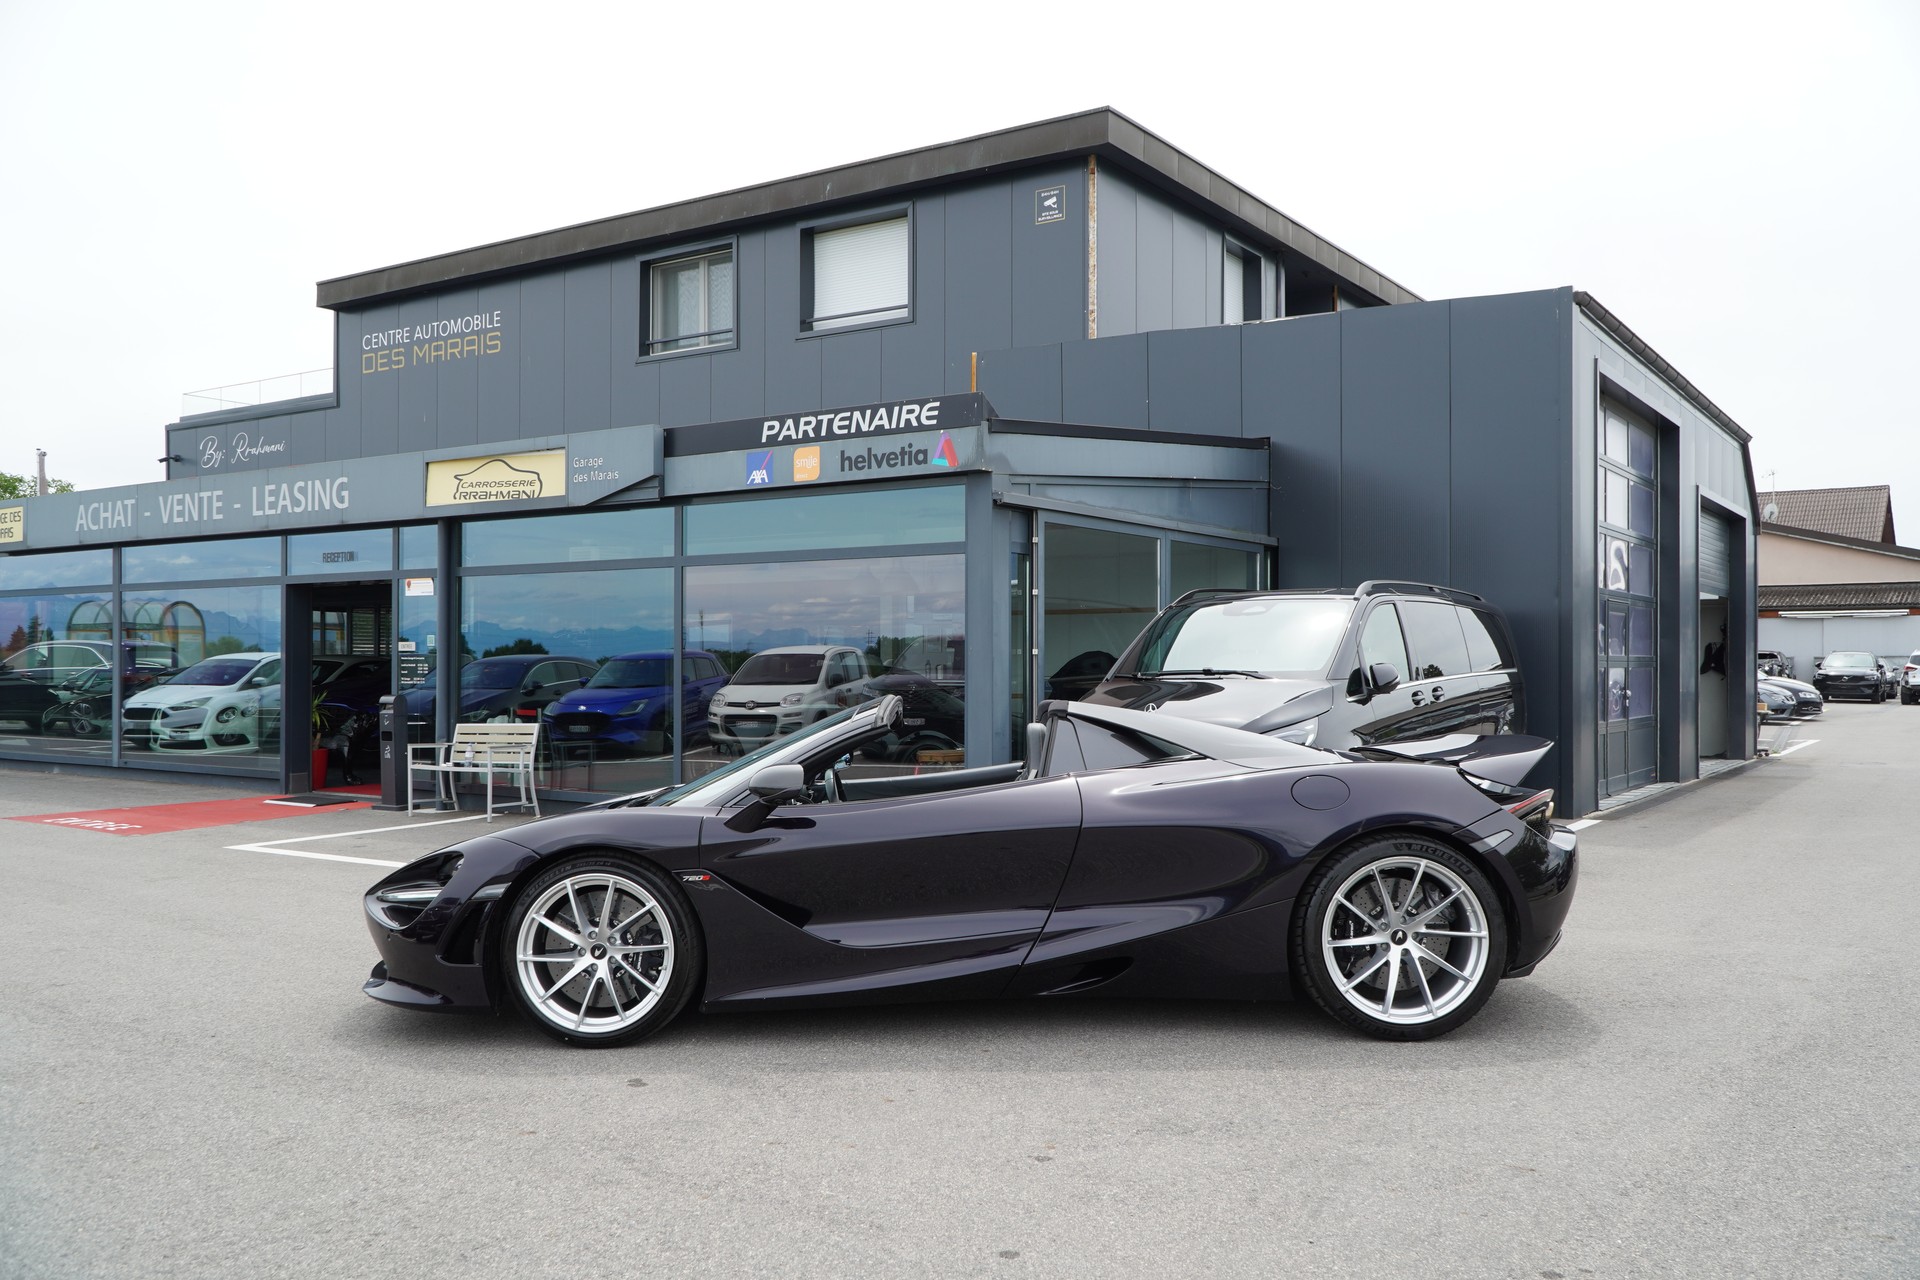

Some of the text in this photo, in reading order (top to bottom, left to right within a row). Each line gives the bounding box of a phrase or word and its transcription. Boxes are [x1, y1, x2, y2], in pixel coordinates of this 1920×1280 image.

[362, 311, 501, 350] CENTRE AUTOMOBILE
[362, 331, 501, 374] DES MARAIS
[761, 401, 941, 443] PARTENAIRE
[199, 435, 226, 468] By:
[573, 457, 604, 468] Garage
[795, 455, 818, 469] smile
[839, 442, 928, 472] helvetia
[461, 480, 537, 489] CARROSSERIE
[573, 470, 619, 483] des Marais
[746, 469, 769, 485] AXA
[0, 510, 22, 524] GE DES
[75, 499, 136, 532] ACHAT
[158, 490, 223, 524] VENTE
[252, 477, 349, 517] LEASING
[1410, 844, 1470, 872] MICHELIN
